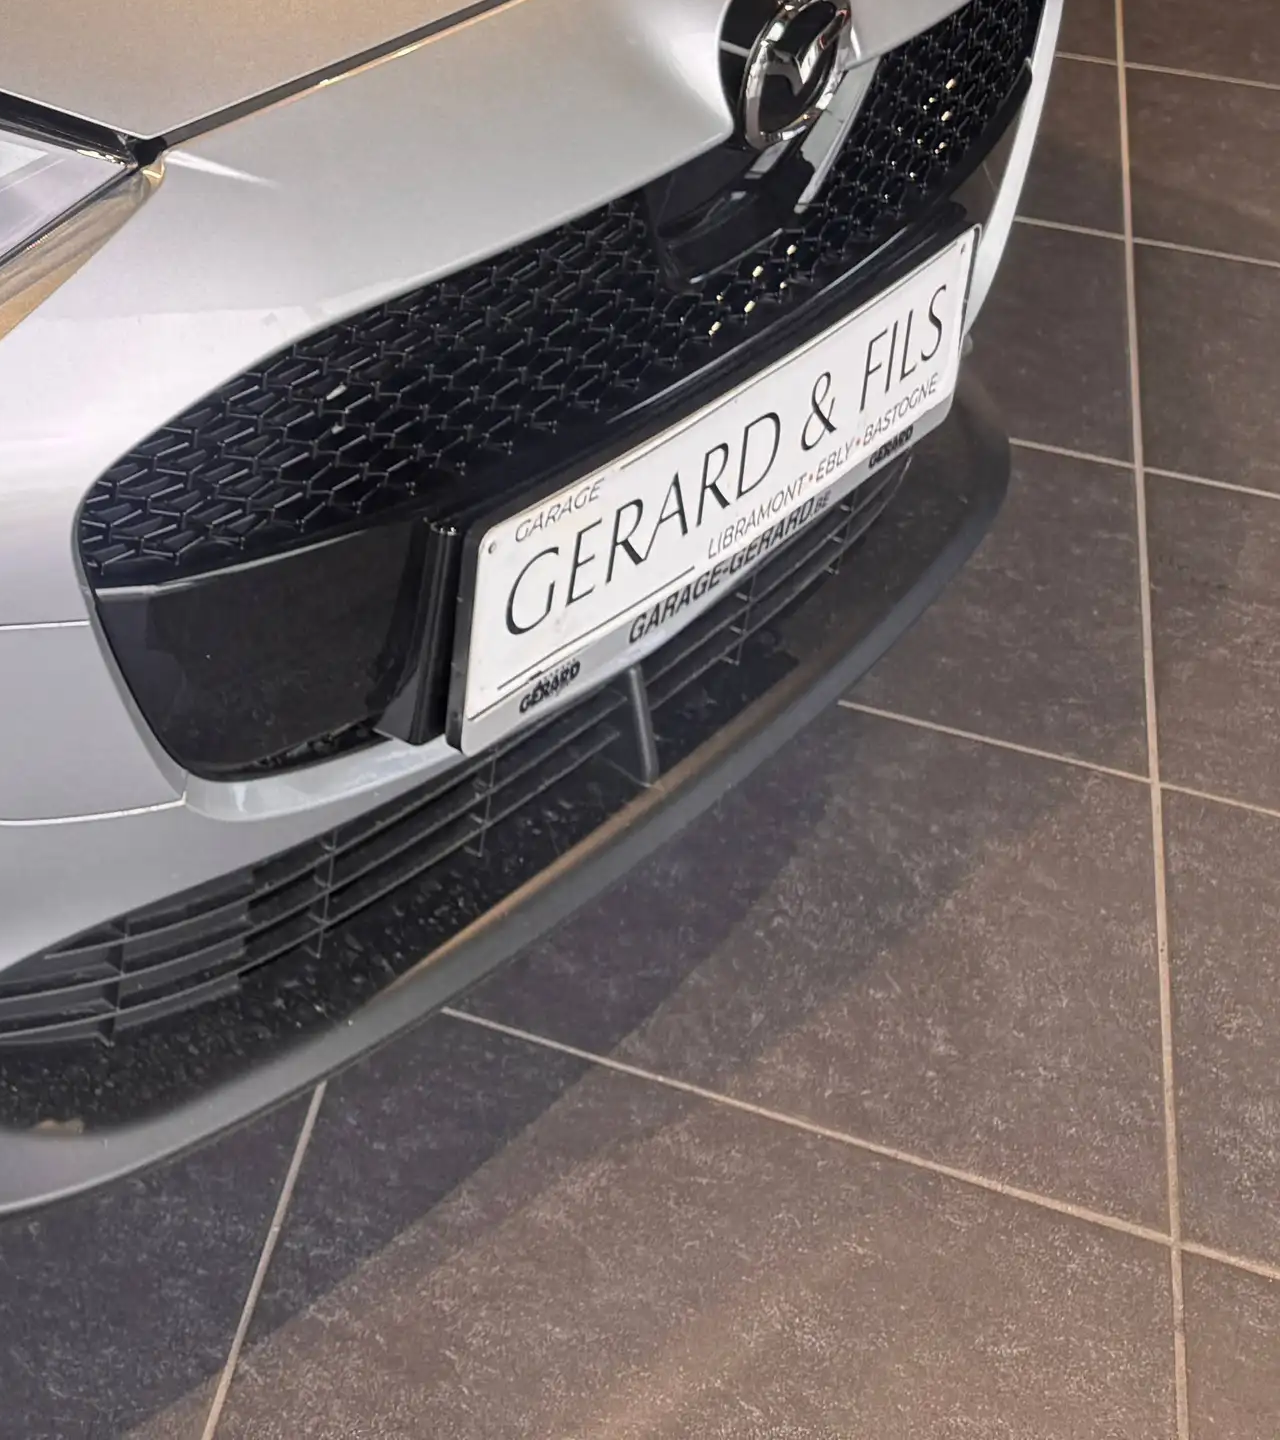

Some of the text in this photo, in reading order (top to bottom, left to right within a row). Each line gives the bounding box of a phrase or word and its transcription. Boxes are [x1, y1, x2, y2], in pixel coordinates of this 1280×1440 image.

[505, 282, 948, 636] GERARD & FILS
[514, 476, 607, 543] GARAGE
[707, 372, 940, 560] LIBRAMONT EBLY BASTOGNE
